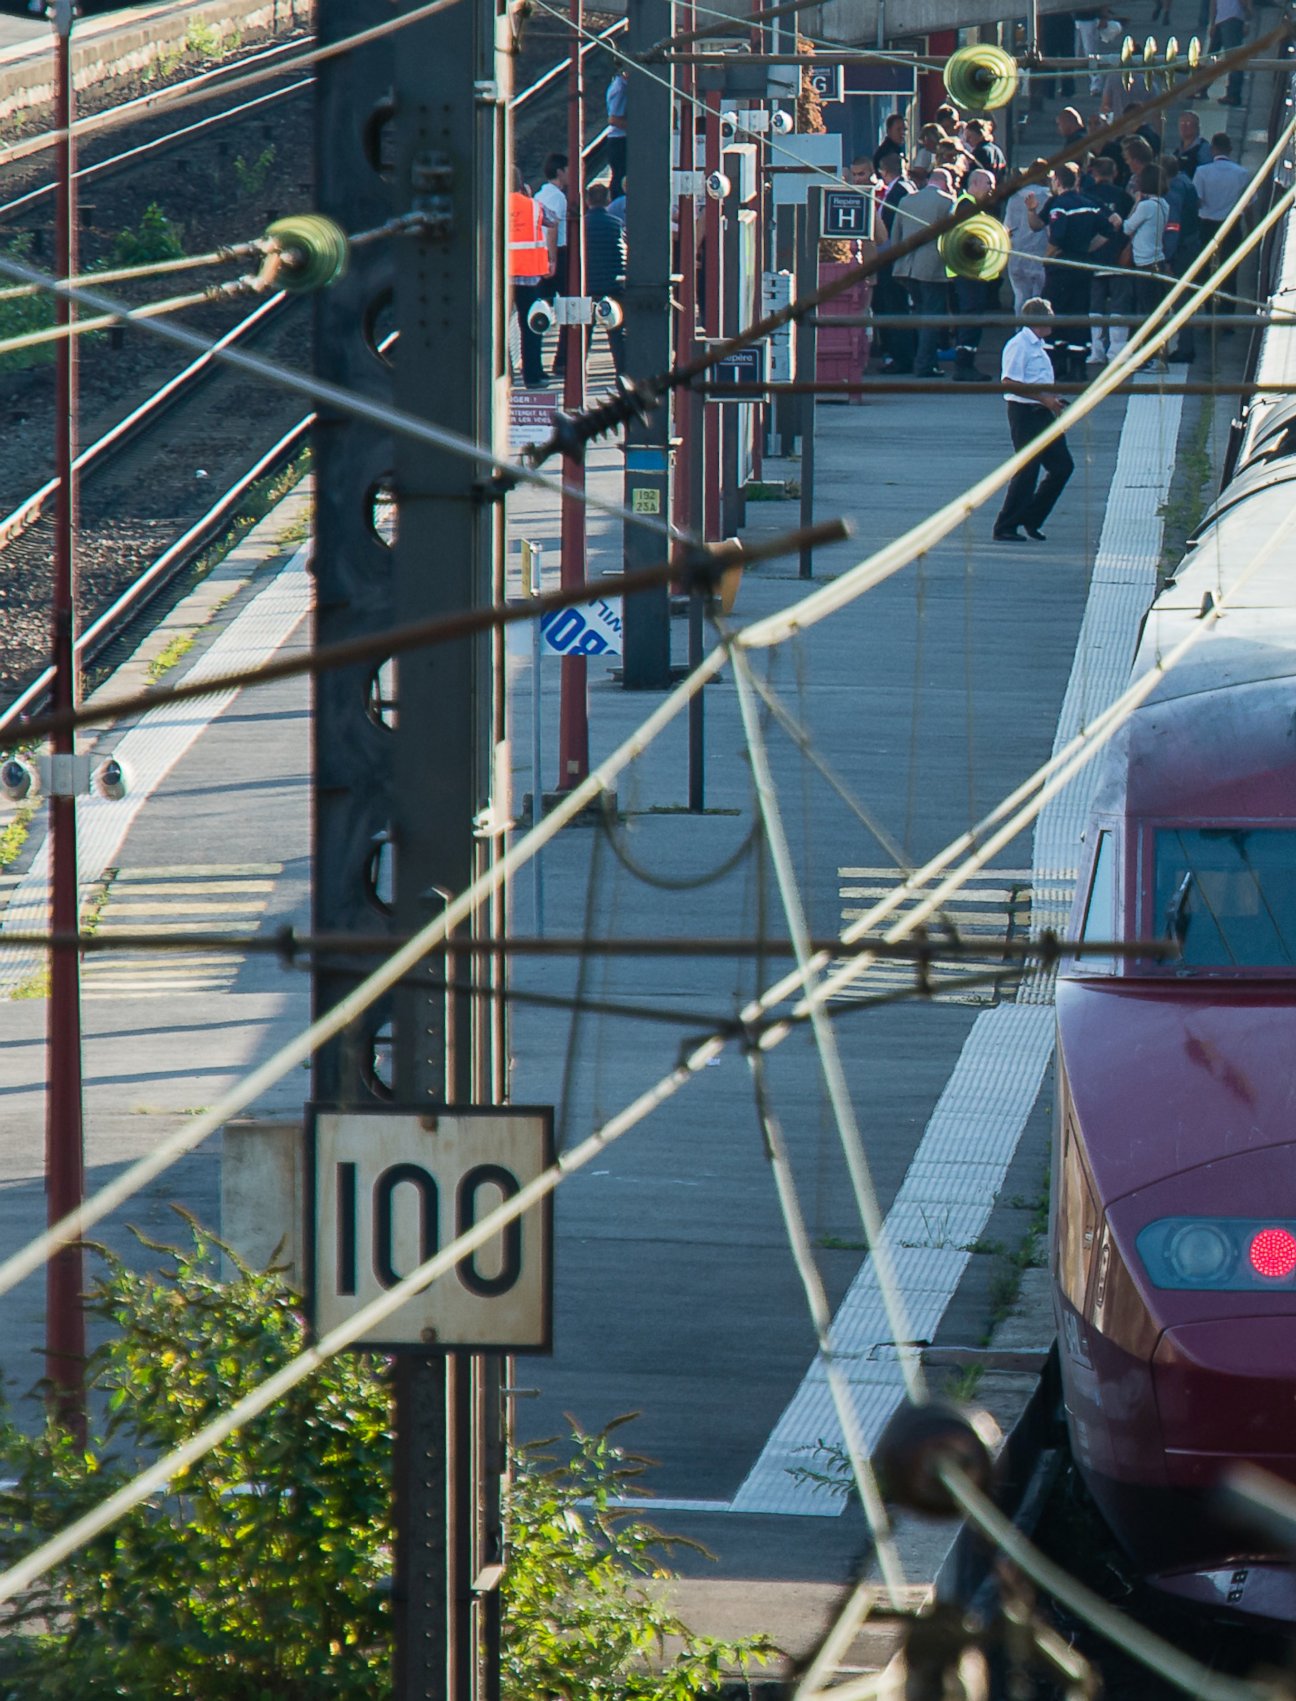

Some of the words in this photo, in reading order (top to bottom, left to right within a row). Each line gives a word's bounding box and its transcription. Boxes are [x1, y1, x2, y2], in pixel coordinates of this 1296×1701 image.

[812, 76, 827, 93] G
[838, 208, 855, 228] H
[336, 1161, 521, 1298] 100
